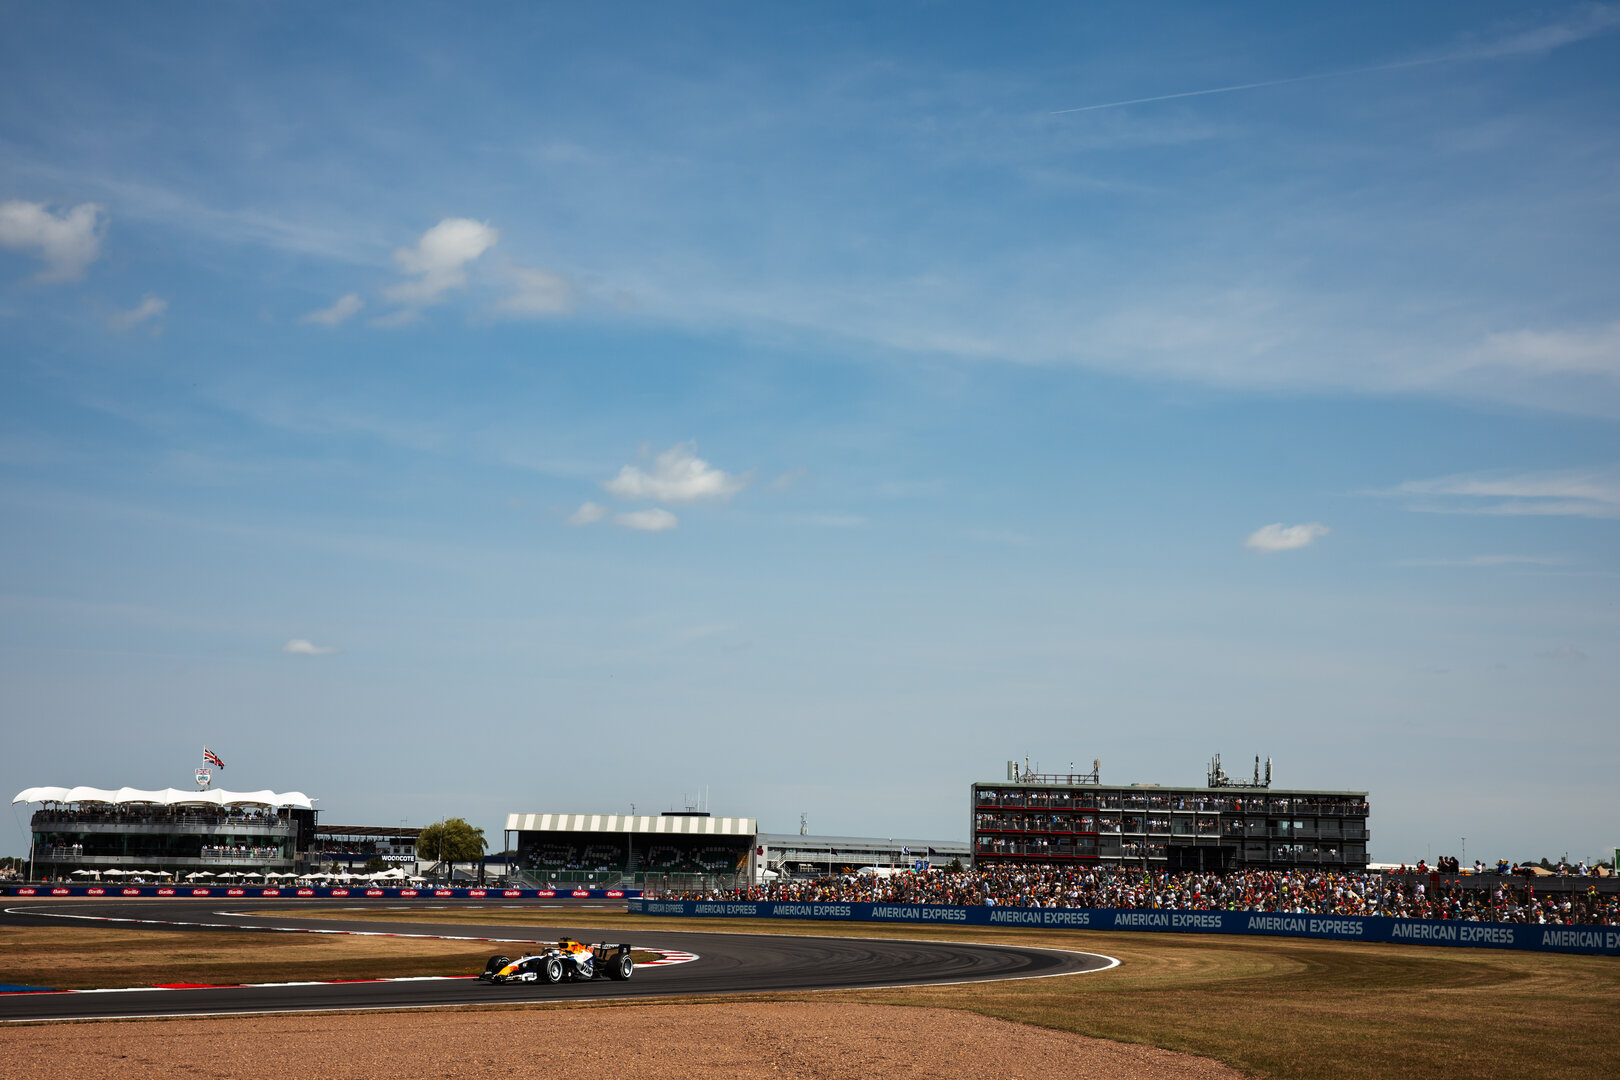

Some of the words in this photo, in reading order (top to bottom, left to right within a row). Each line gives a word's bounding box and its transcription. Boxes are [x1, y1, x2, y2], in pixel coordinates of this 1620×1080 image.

[695, 904, 724, 914] AMERICAN
[727, 905, 756, 914] EXPRESS
[774, 904, 812, 916] AMERICAN
[814, 906, 850, 916] EXPRESS
[872, 907, 920, 919] AMERICAN
[922, 908, 966, 920] EXPRESS
[990, 910, 1040, 922] AMERICAN
[1044, 912, 1090, 924] EXPRESS
[1114, 913, 1168, 926] AMERICAN
[1172, 916, 1222, 928] EXPRESS
[1248, 916, 1305, 932] AMERICAN
[1310, 919, 1363, 934] EXPRESS
[1392, 923, 1456, 940] AMERICAN
[1460, 926, 1514, 944] EXPRESS
[1542, 930, 1602, 948] AMERICAN
